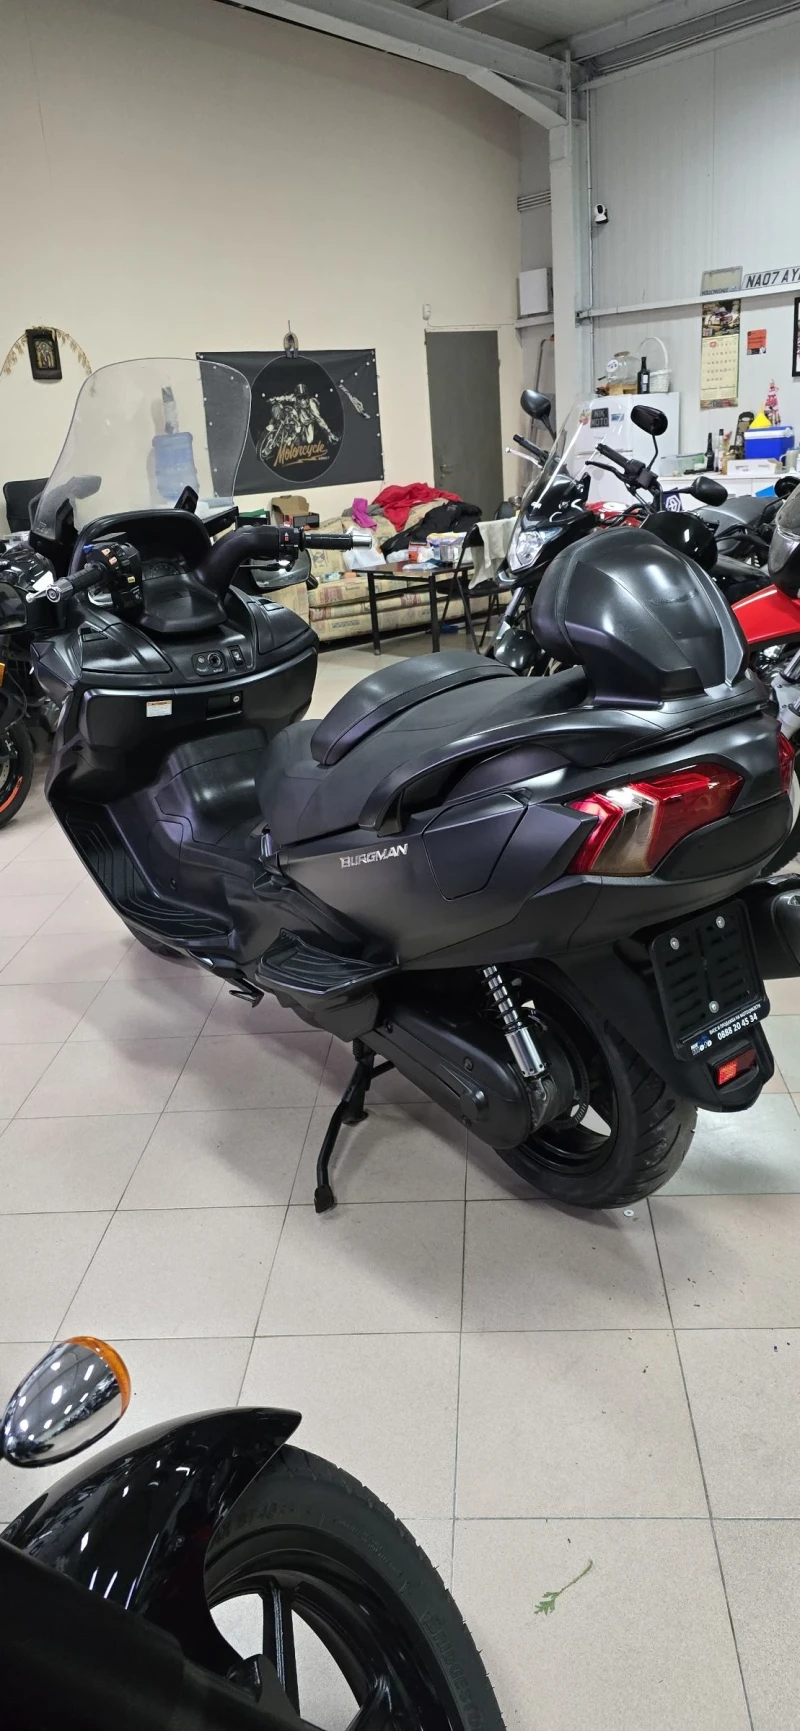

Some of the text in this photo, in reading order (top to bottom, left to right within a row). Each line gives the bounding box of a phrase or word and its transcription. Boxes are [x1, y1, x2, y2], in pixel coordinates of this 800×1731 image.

[745, 271, 780, 288] NA07
[273, 441, 327, 466] Motorcycle
[339, 843, 408, 868] BURGMAN
[717, 1012, 758, 1040] 0888 20 45 34
